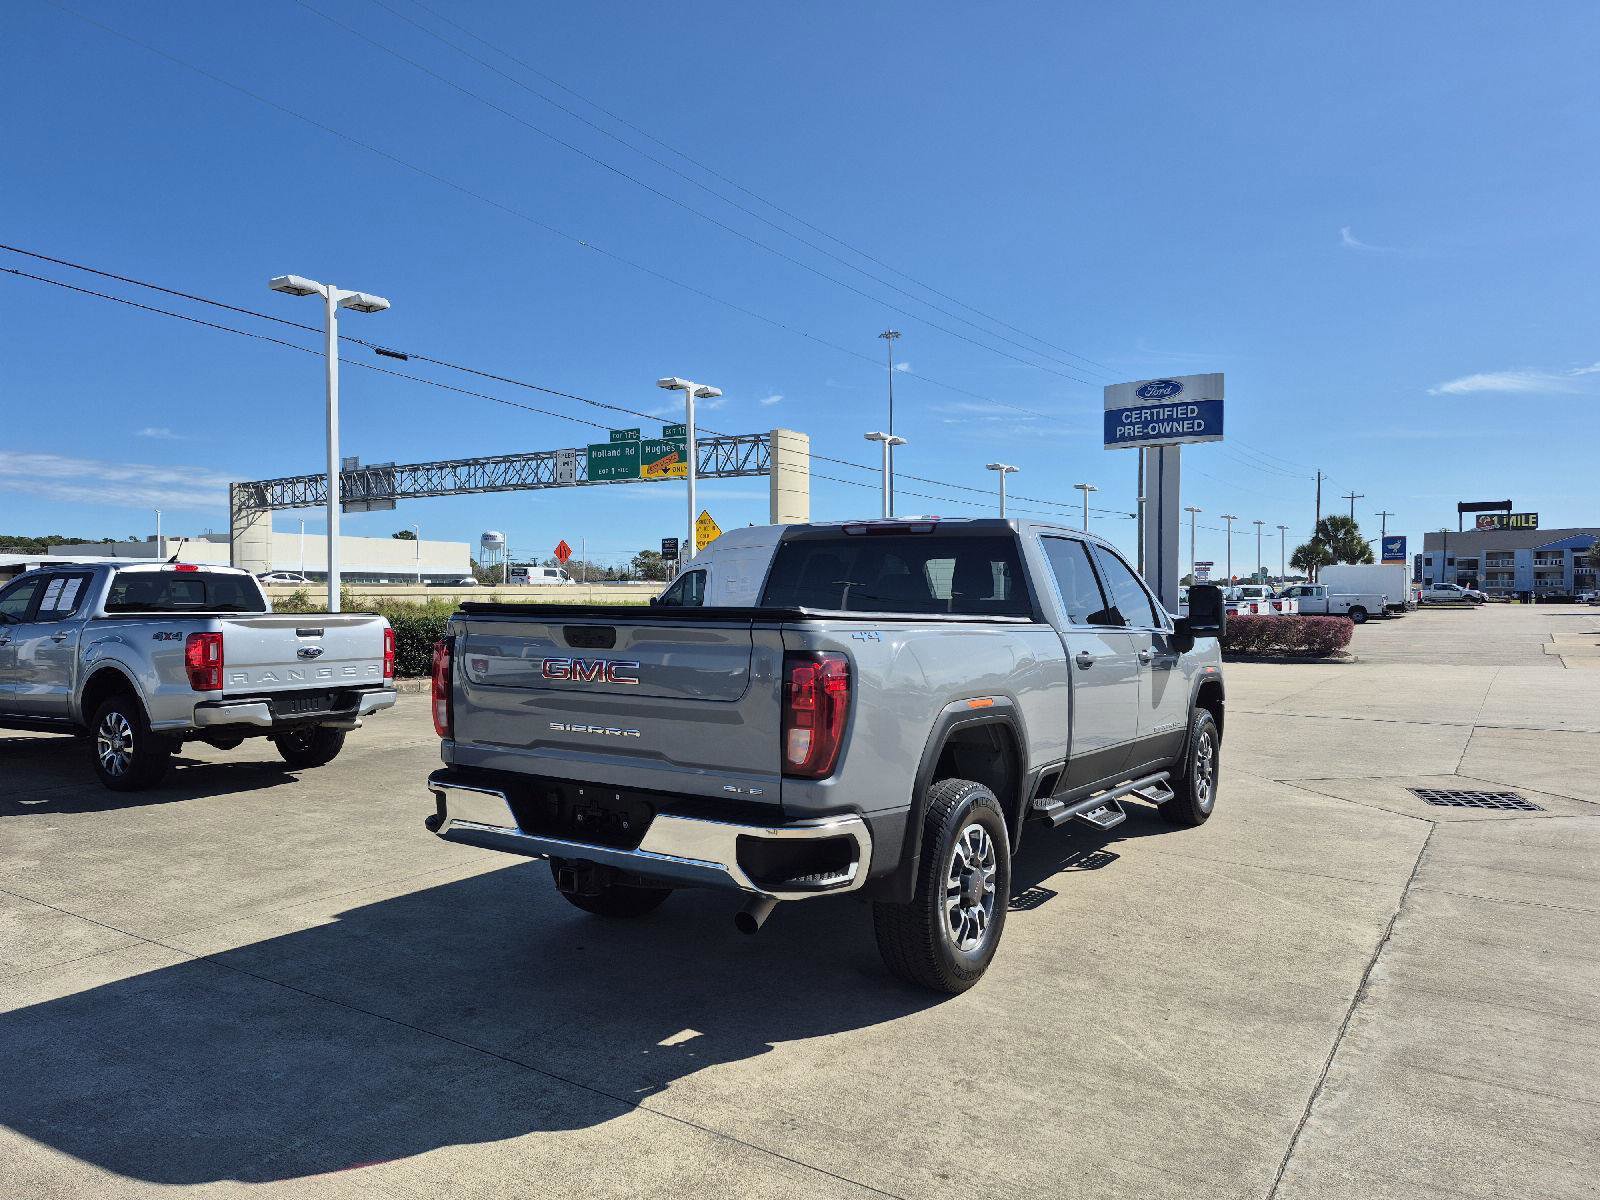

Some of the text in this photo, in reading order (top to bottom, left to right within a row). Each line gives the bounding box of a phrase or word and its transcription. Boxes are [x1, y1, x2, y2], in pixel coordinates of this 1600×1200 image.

[1144, 383, 1172, 397] Ford
[1121, 405, 1199, 423] CERTIFIED
[1116, 419, 1205, 438] PRE-OWNED
[592, 447, 635, 459] Holland Rd
[645, 444, 676, 455] Hughes
[229, 664, 380, 685] RANGER
[541, 657, 641, 685] GMC
[549, 722, 641, 738] SIERRA
